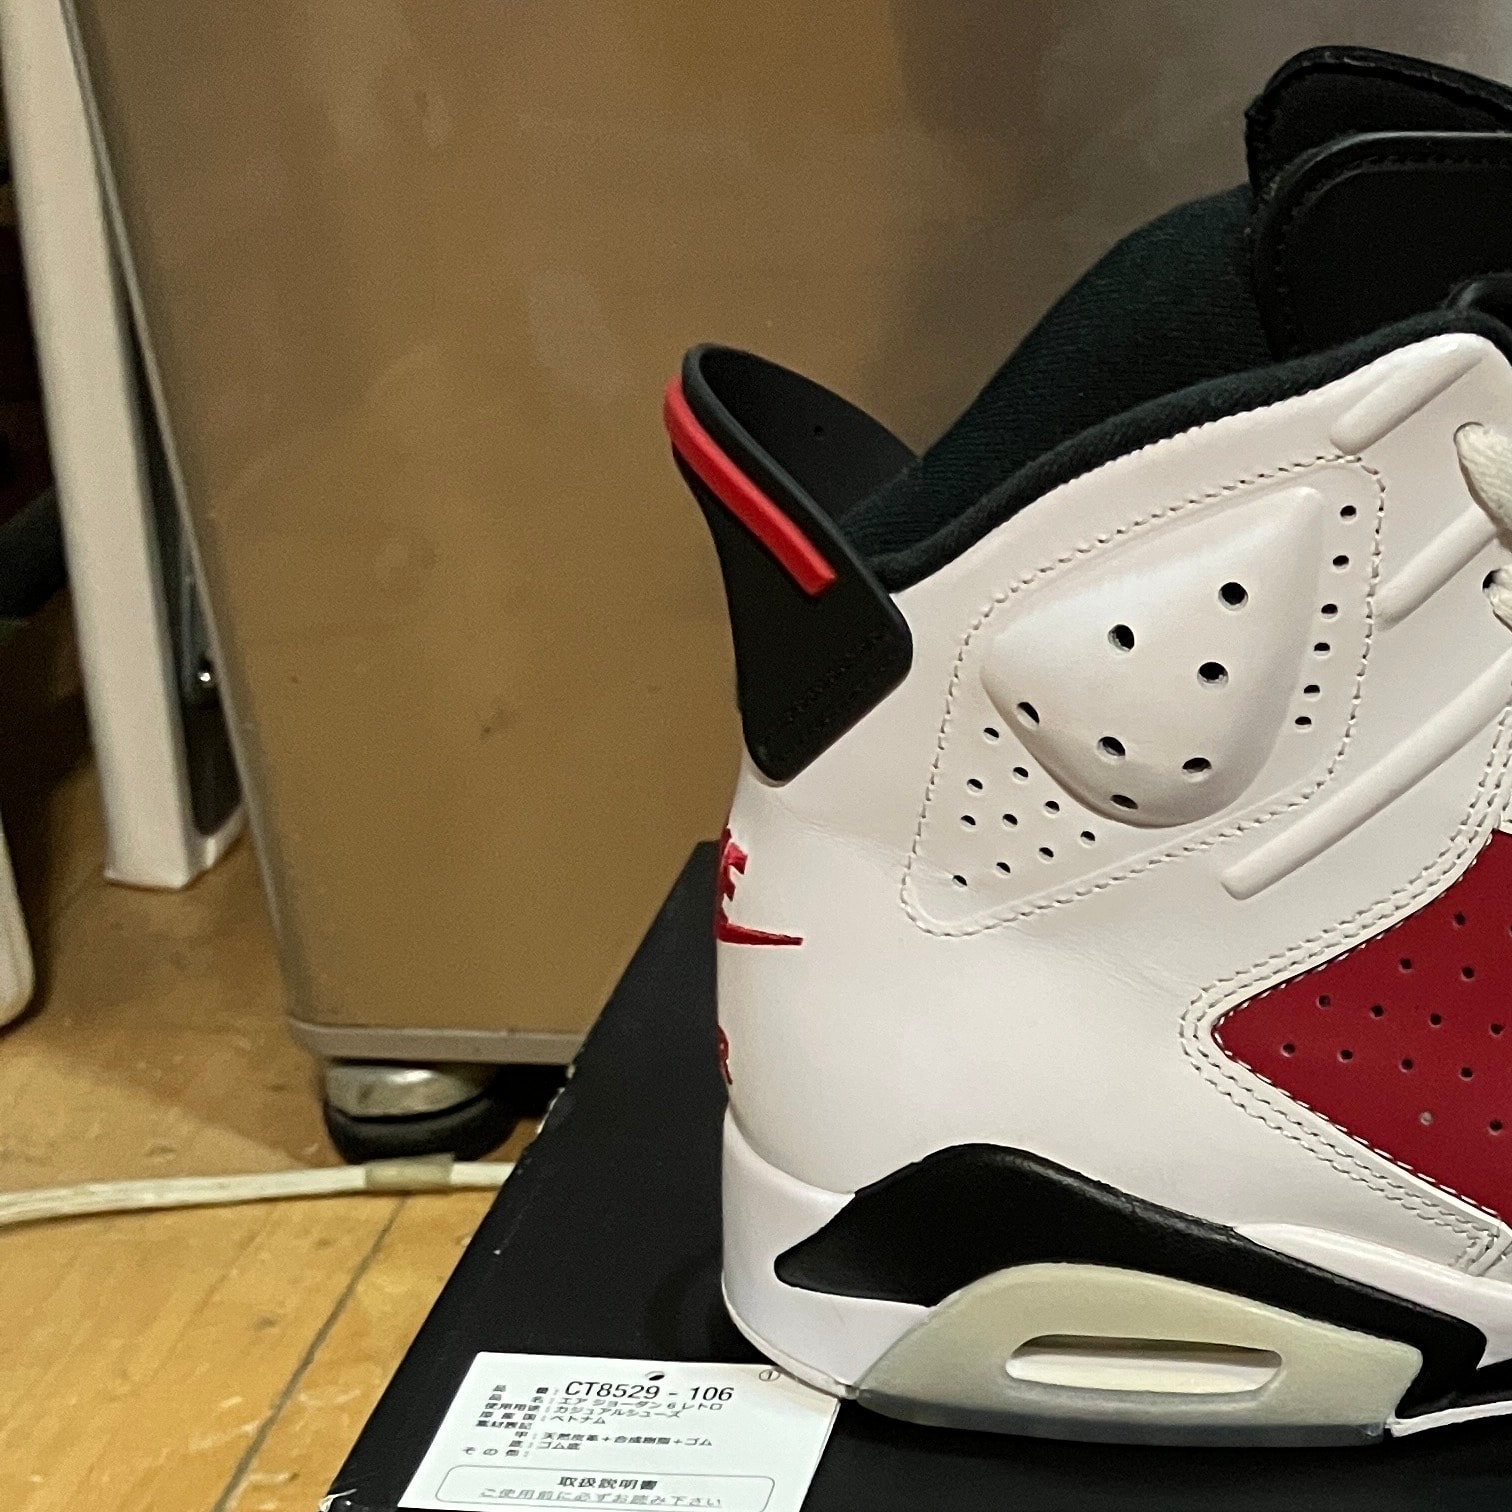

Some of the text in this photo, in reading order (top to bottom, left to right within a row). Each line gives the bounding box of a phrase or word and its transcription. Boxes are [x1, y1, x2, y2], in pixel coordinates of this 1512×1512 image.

[565, 1381, 661, 1400] CT8529
[690, 1386, 735, 1401] 106
[554, 1405, 681, 1418] カジュアルシューズ
[557, 1476, 657, 1491] 取扱説明書
